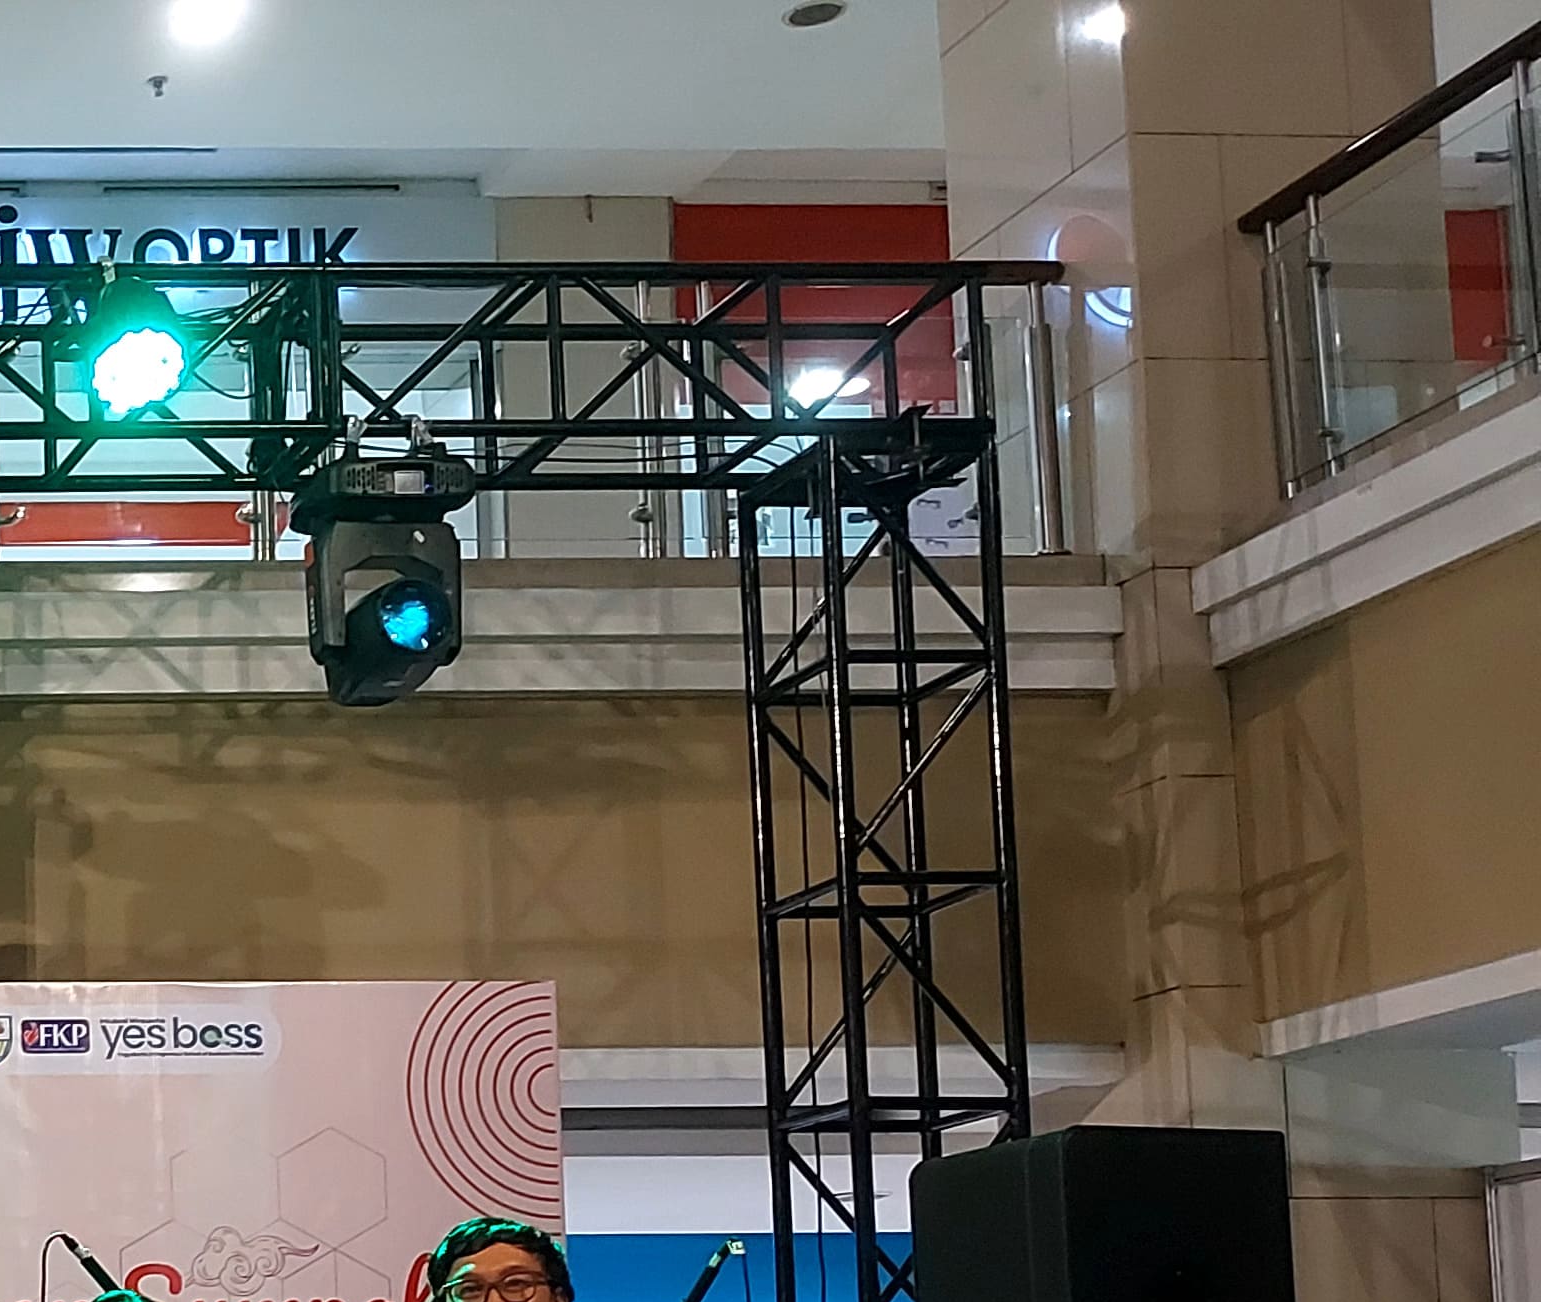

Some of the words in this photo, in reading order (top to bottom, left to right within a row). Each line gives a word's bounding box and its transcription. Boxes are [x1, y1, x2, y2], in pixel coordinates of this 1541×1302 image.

[39, 1023, 88, 1047] FKP
[100, 1024, 166, 1060] yes
[172, 1016, 263, 1049] boss
